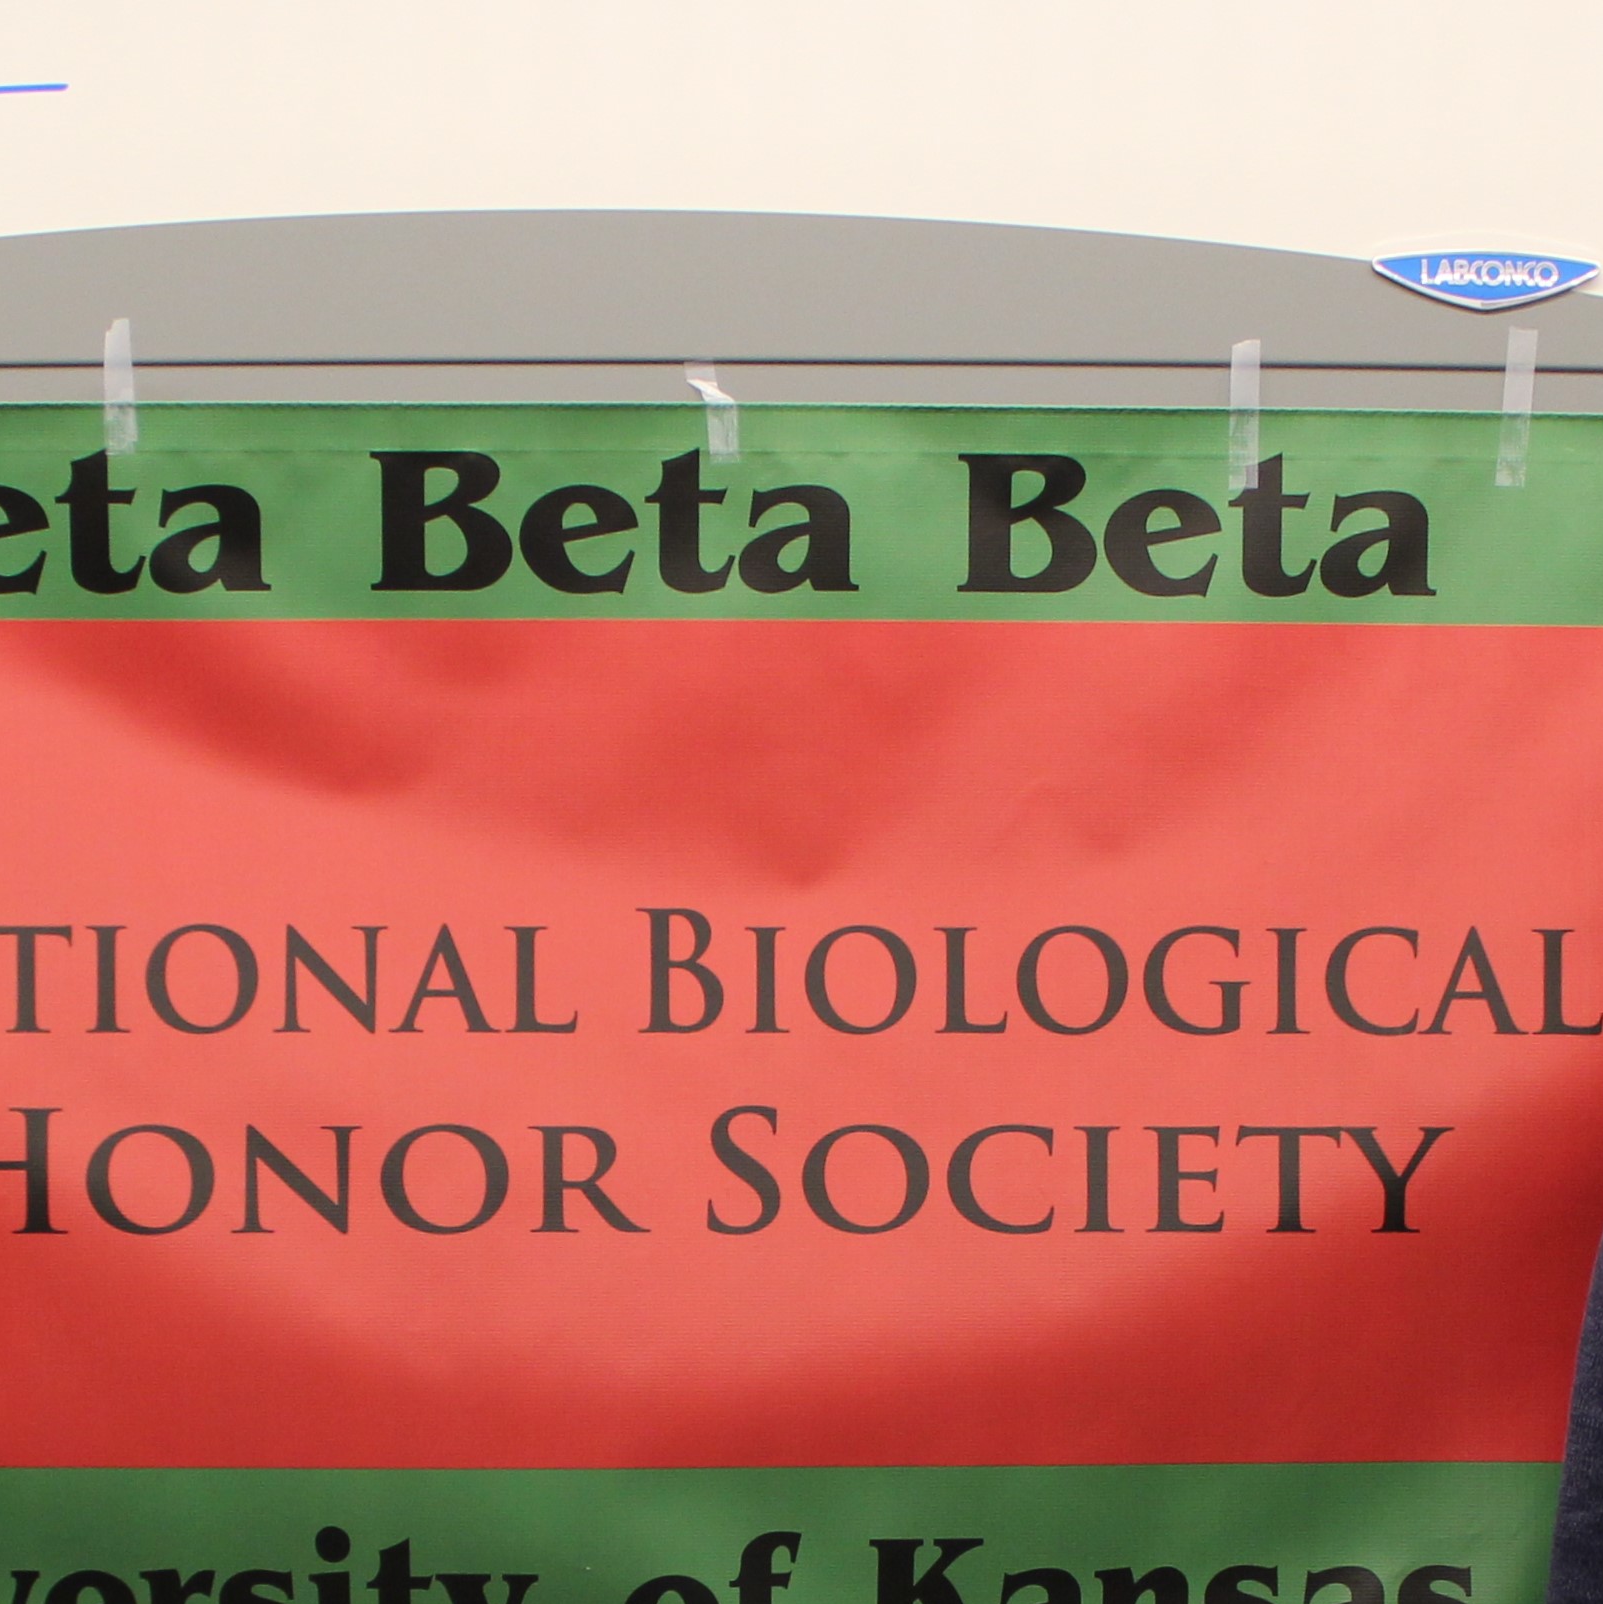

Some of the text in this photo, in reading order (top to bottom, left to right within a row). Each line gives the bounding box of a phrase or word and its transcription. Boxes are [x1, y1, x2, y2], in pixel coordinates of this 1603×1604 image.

[1421, 258, 1559, 288] LABCONCO
[369, 448, 859, 594] Beta
[957, 453, 1438, 598] Beta
[639, 909, 1603, 1035] BIOLOGICAL
[709, 1106, 1453, 1236] SOCIETY
